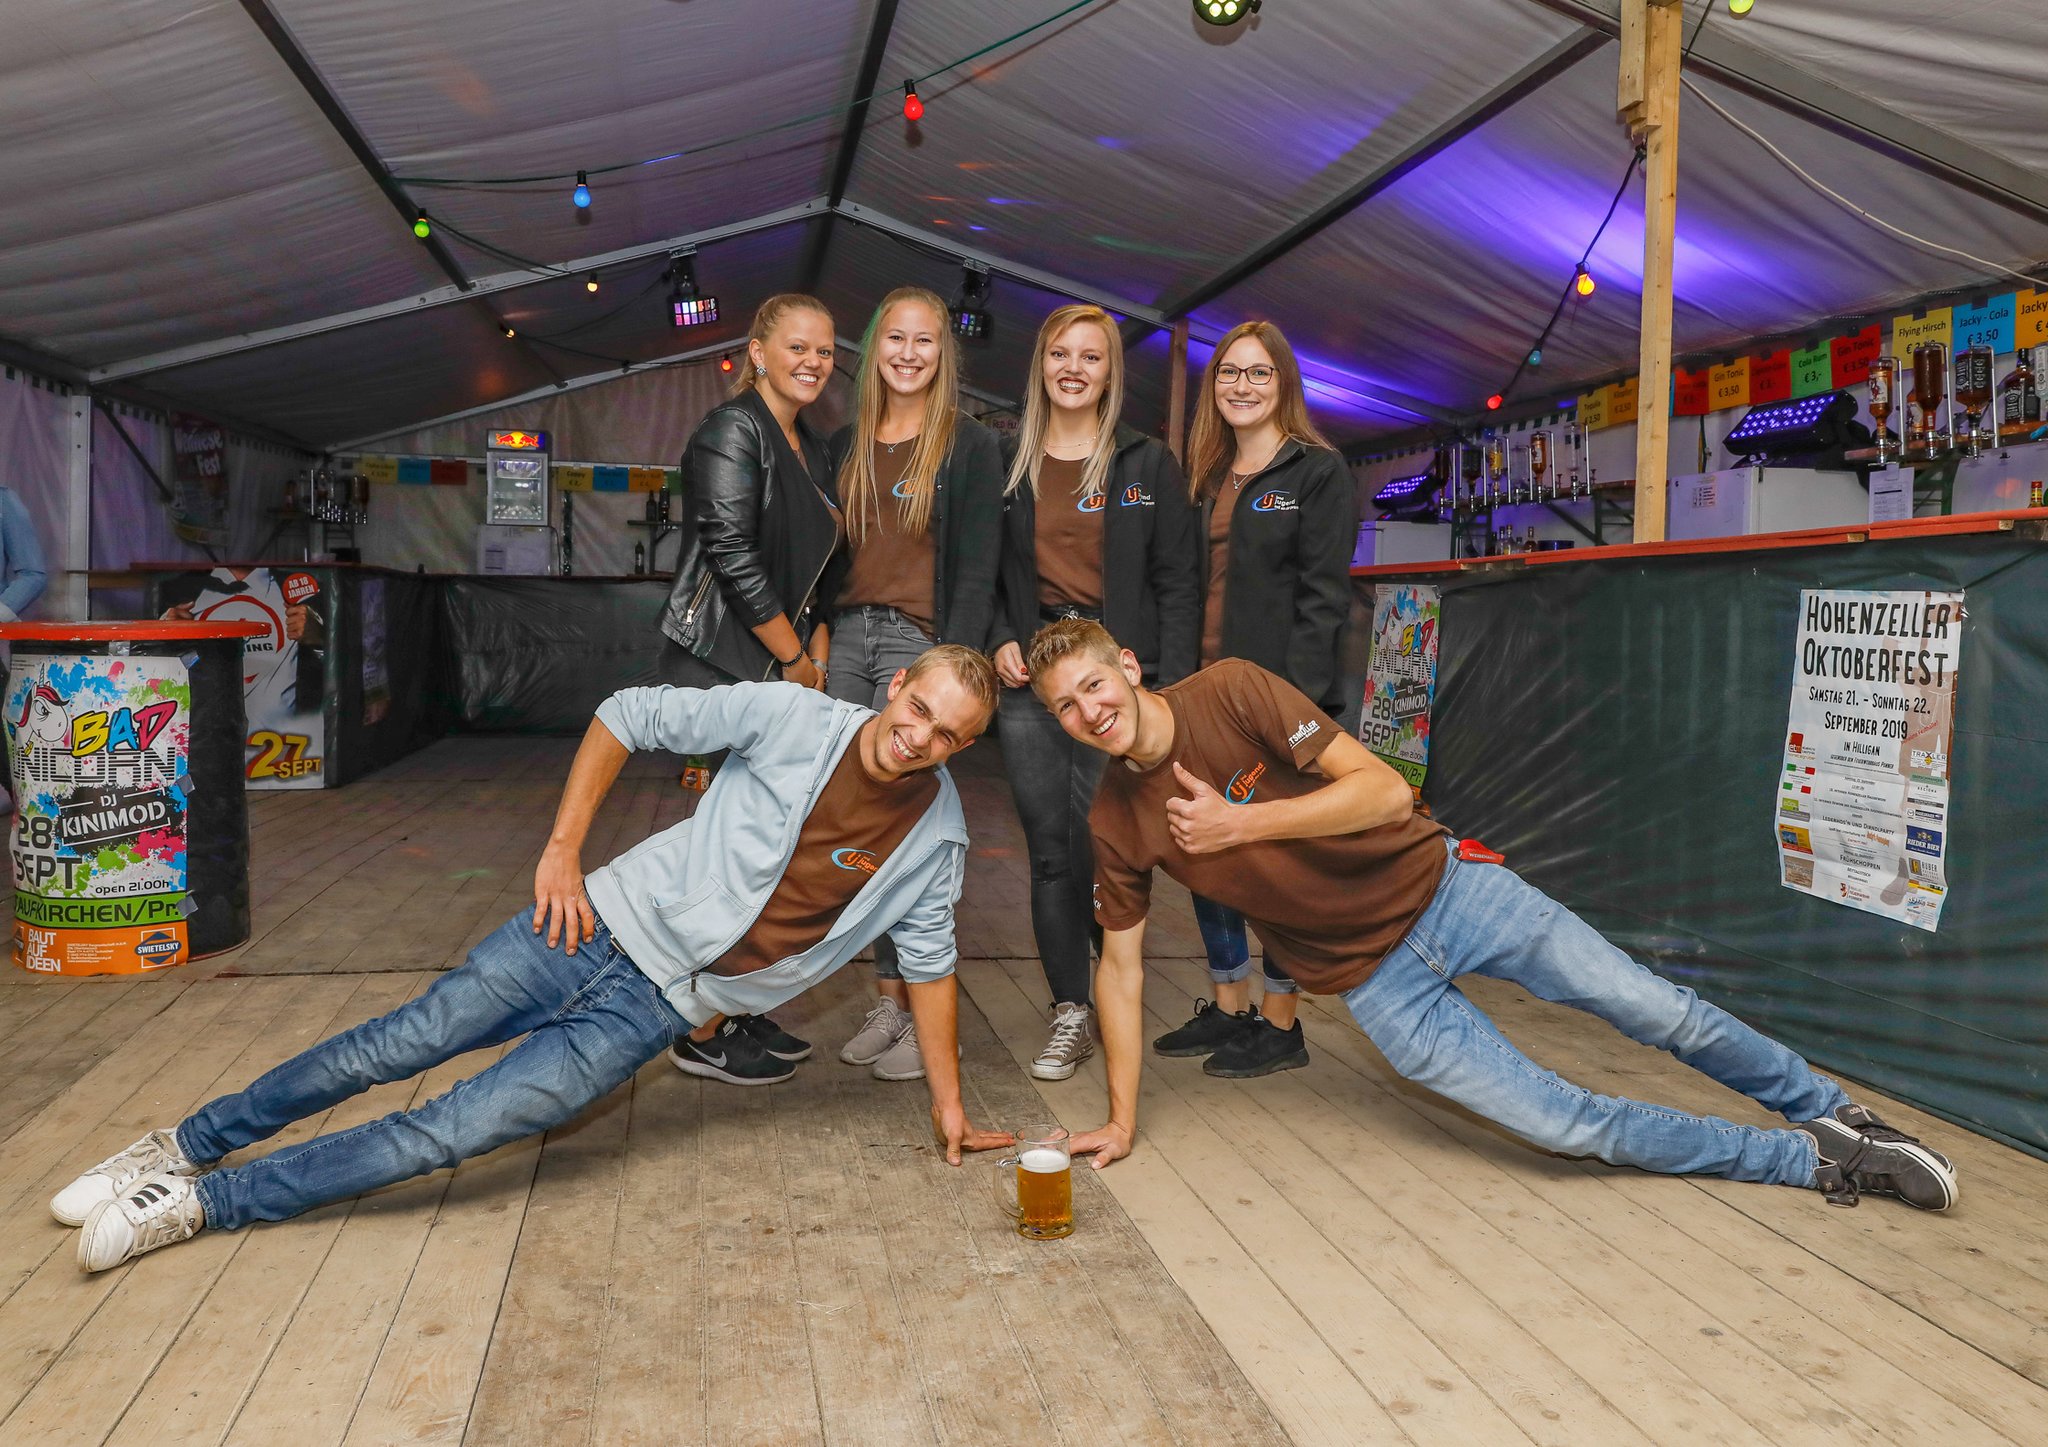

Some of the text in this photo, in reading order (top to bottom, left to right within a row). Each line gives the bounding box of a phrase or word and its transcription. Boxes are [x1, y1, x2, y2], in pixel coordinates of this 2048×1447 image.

[2020, 301, 2048, 315] Jacky
[1960, 315, 1981, 328] Jacky
[1989, 308, 2009, 320] Cola
[1898, 320, 1947, 338] Flying Hirsch
[1975, 328, 1998, 344] 3,50
[1798, 357, 1812, 368] Cola
[1714, 367, 1745, 383] Gin Tonic
[1724, 384, 1740, 397] 3,50
[288, 576, 309, 589] AB 18
[287, 585, 315, 599] JAHREN
[1806, 595, 1951, 639] HOHENZELLER
[1402, 617, 1435, 657] BAD
[1803, 638, 1949, 687] OKTOBERFEST
[1407, 685, 1414, 694] DJ
[1394, 693, 1427, 713] KINIMOD
[1809, 686, 1843, 704] SAMSTAG
[1846, 690, 1859, 706] 21.
[1872, 692, 1910, 712] SONNTAG
[1913, 697, 1931, 714] 22.
[71, 700, 178, 758] BAD
[1824, 711, 1877, 736] SEPTEMBER
[1882, 718, 1908, 740] 2019
[1362, 721, 1399, 750] SEPT
[246, 731, 308, 779] 27
[1852, 740, 1881, 757] HILLIGAN
[1912, 750, 1947, 761] TRAXLER
[279, 757, 321, 779] SEPT
[100, 793, 118, 807] DJ
[63, 801, 166, 838] KINIMOD
[1907, 838, 1927, 849] RIEDER
[1927, 841, 1940, 852] BIER
[13, 850, 83, 890] SEPT
[857, 857, 878, 872] jugen
[1839, 854, 1881, 870] FRÜHSCHOPPEN
[95, 880, 169, 896] open 21.00h
[28, 929, 57, 946] BAUT
[27, 944, 47, 958] AUF
[137, 942, 179, 955] SWIETELSKY
[26, 957, 61, 972] IDEEN
